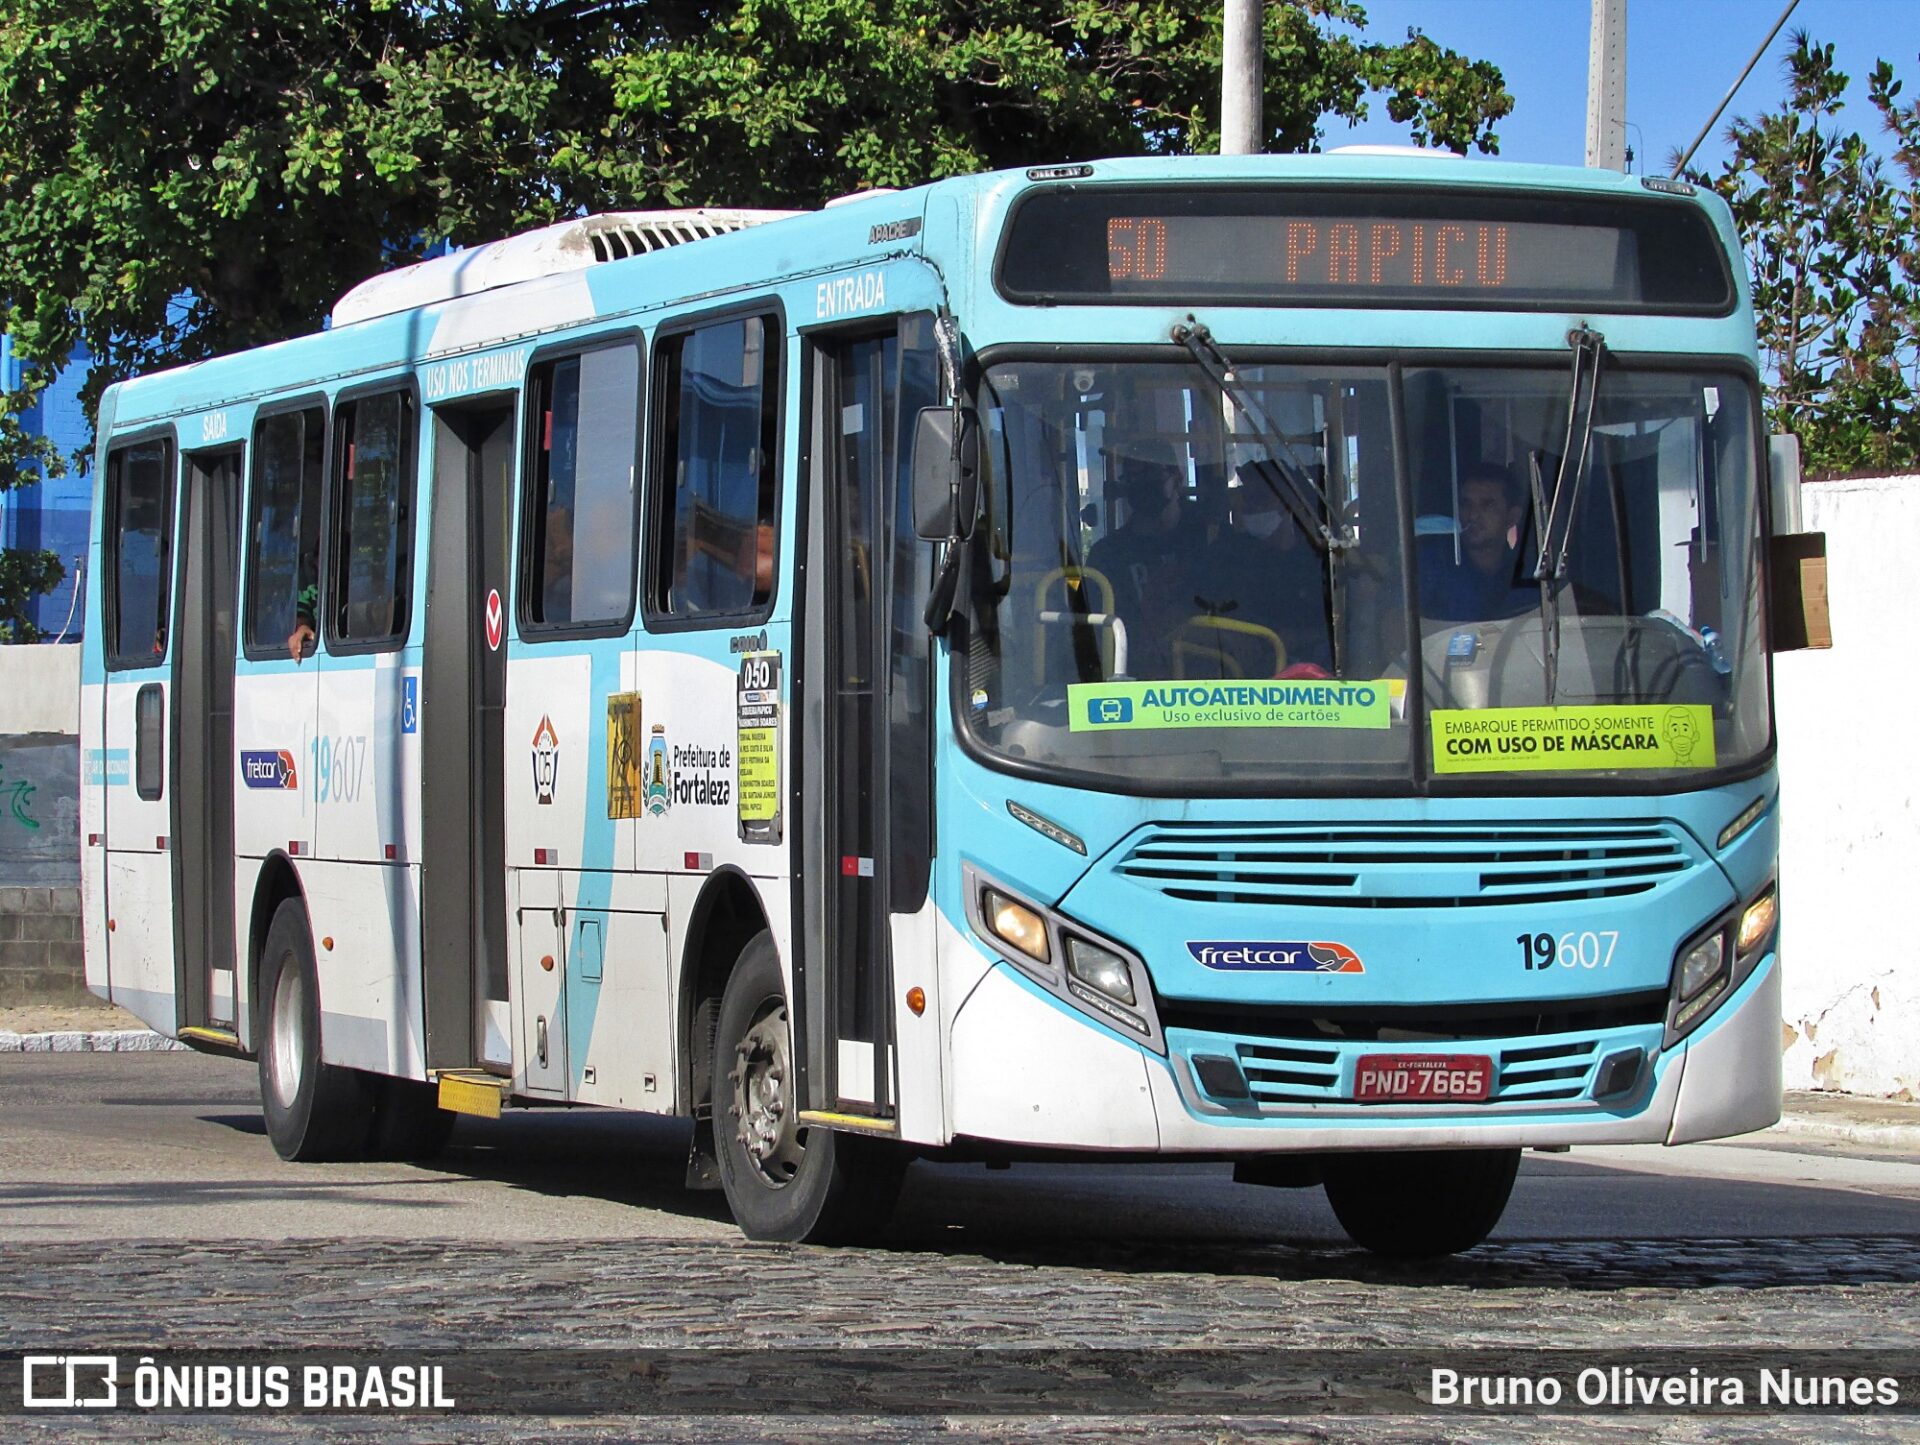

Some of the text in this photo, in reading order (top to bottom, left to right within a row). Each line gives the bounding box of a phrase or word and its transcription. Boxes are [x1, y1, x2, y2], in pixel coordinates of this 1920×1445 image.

[868, 220, 907, 245] APACHE
[1287, 222, 1506, 284] PAPICU
[816, 271, 885, 319] ENTRADA
[427, 349, 525, 398] USO NOS TERMINAIS
[203, 409, 227, 441] SAÍDA
[744, 661, 770, 689] 050
[1141, 686, 1376, 708] AUTOATENDIMENTO
[1163, 709, 1341, 722] Uso exclusivo de cartões
[1445, 716, 1655, 734] EMBARQUE PERMITIDO SOMENTE
[673, 743, 731, 768] Prefeitura de
[1446, 730, 1659, 755] COM USO DE MÁSCARA
[247, 735, 366, 804] fretcar 19607
[673, 770, 730, 806] Fortaleza
[1199, 947, 1302, 964] fretcar
[1516, 931, 1619, 970] 19607
